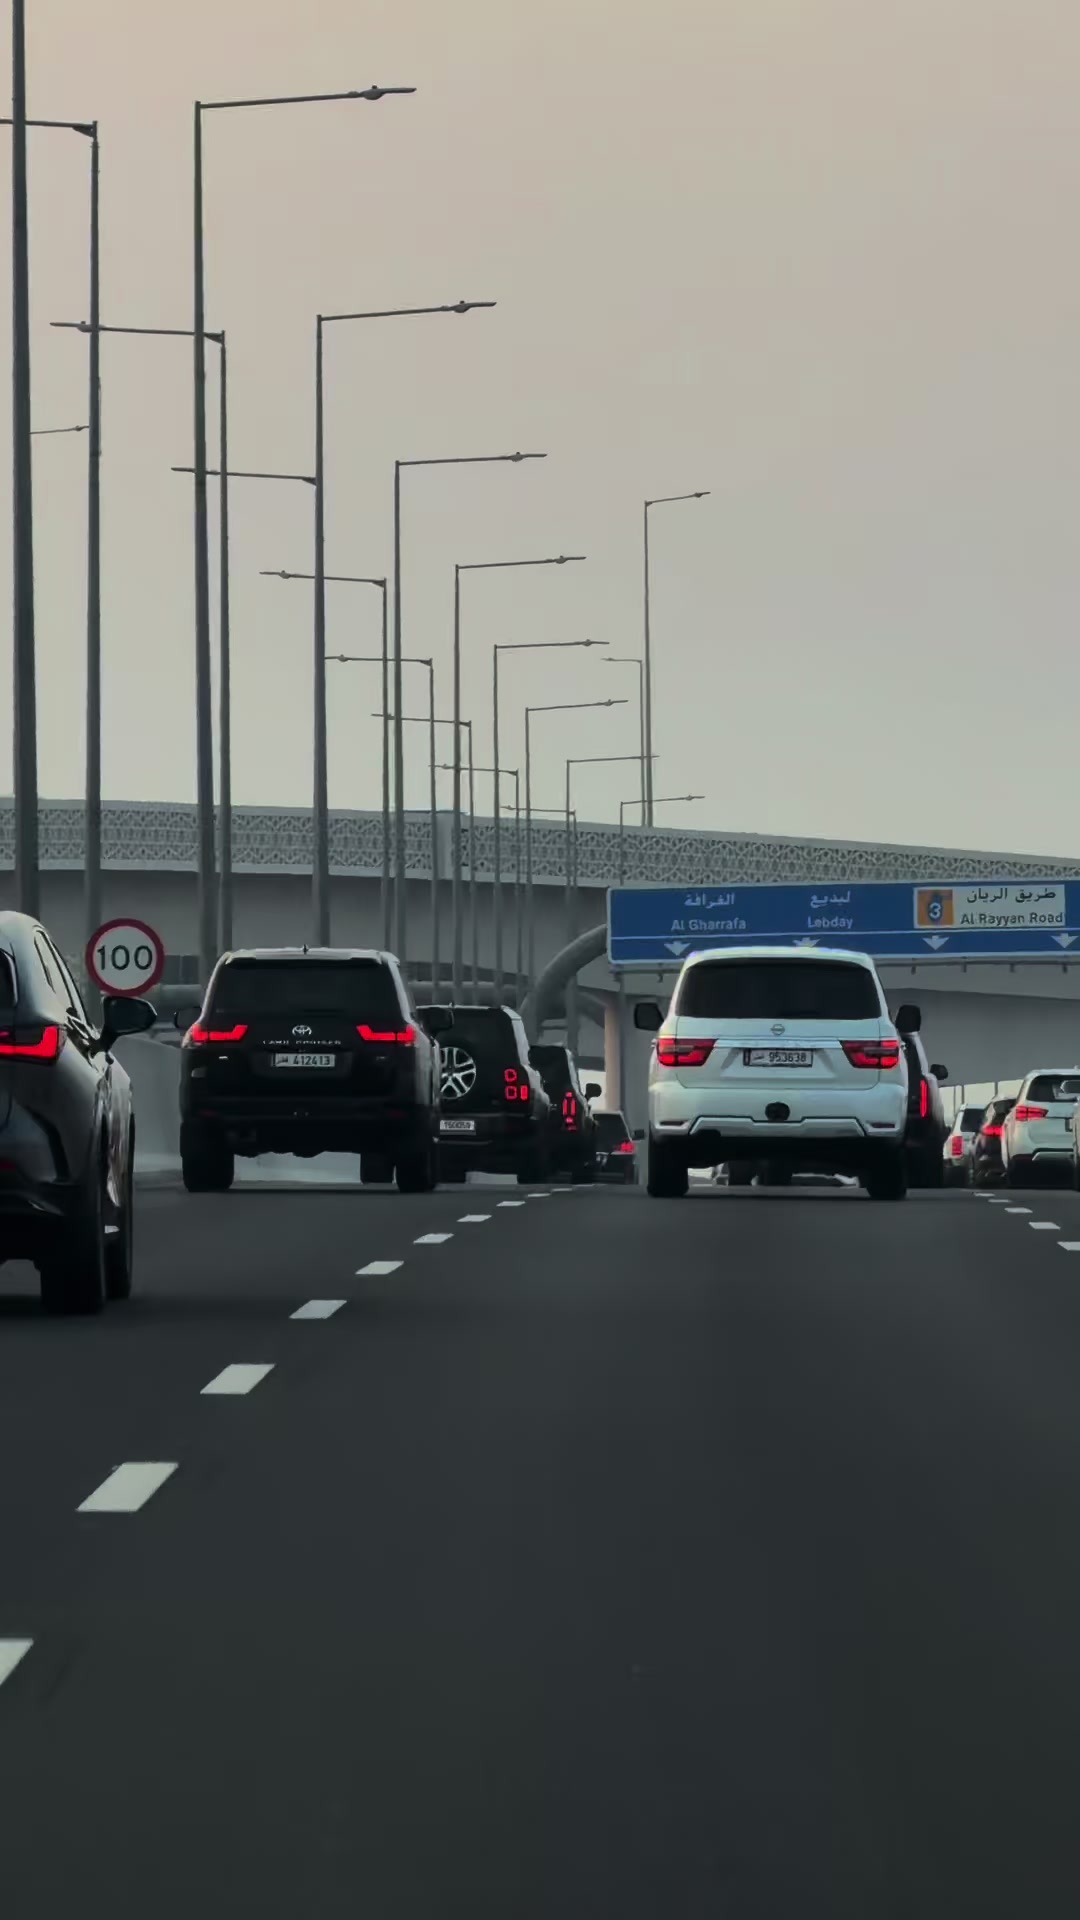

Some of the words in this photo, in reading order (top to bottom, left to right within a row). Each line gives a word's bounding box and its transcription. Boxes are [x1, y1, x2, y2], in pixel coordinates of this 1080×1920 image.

[684, 893, 735, 909] الغرافة
[966, 888, 1008, 903] الريان
[1015, 888, 1056, 903] طريق
[928, 903, 941, 919] 3
[671, 919, 684, 931] Al
[688, 917, 746, 930] Gharrafa
[807, 916, 853, 929] Lebday
[960, 914, 975, 925] Al
[979, 913, 1025, 927] Rayyan
[1029, 912, 1064, 924] Road
[97, 944, 153, 971] 100
